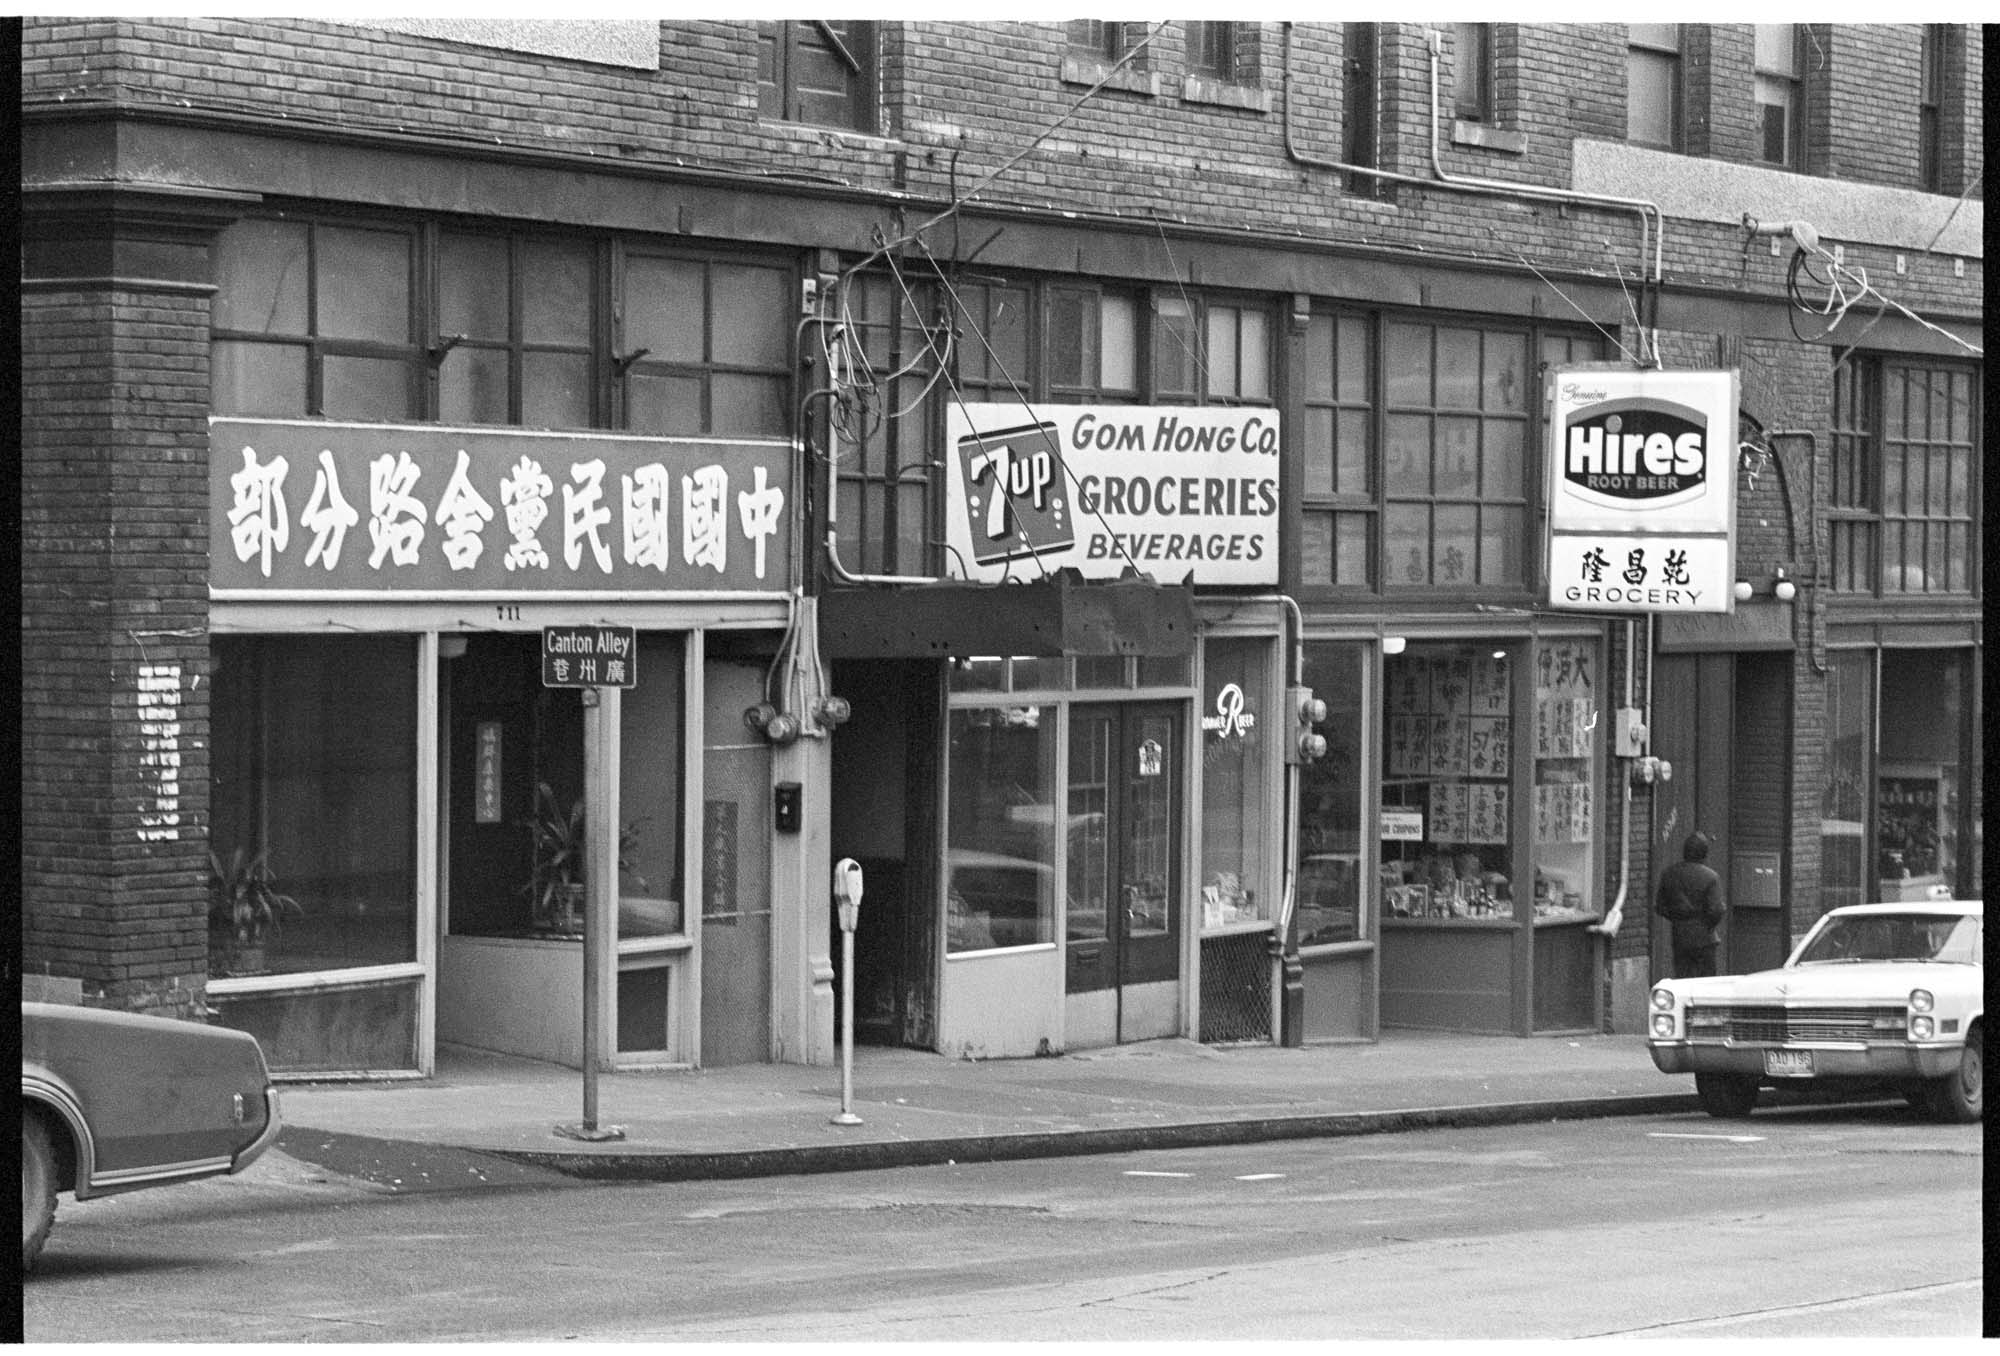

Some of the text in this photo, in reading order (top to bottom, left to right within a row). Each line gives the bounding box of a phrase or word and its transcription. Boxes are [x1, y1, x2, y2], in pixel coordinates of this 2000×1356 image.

[1569, 415, 1704, 477] Hires
[1077, 475, 1278, 517] GROCERIES
[1587, 475, 1679, 490] ROOT BEER
[1086, 532, 1264, 562] BEVERAGES
[1565, 586, 1703, 605] GROCERY
[496, 606, 520, 621] 711
[547, 630, 631, 658] Canton Alley
